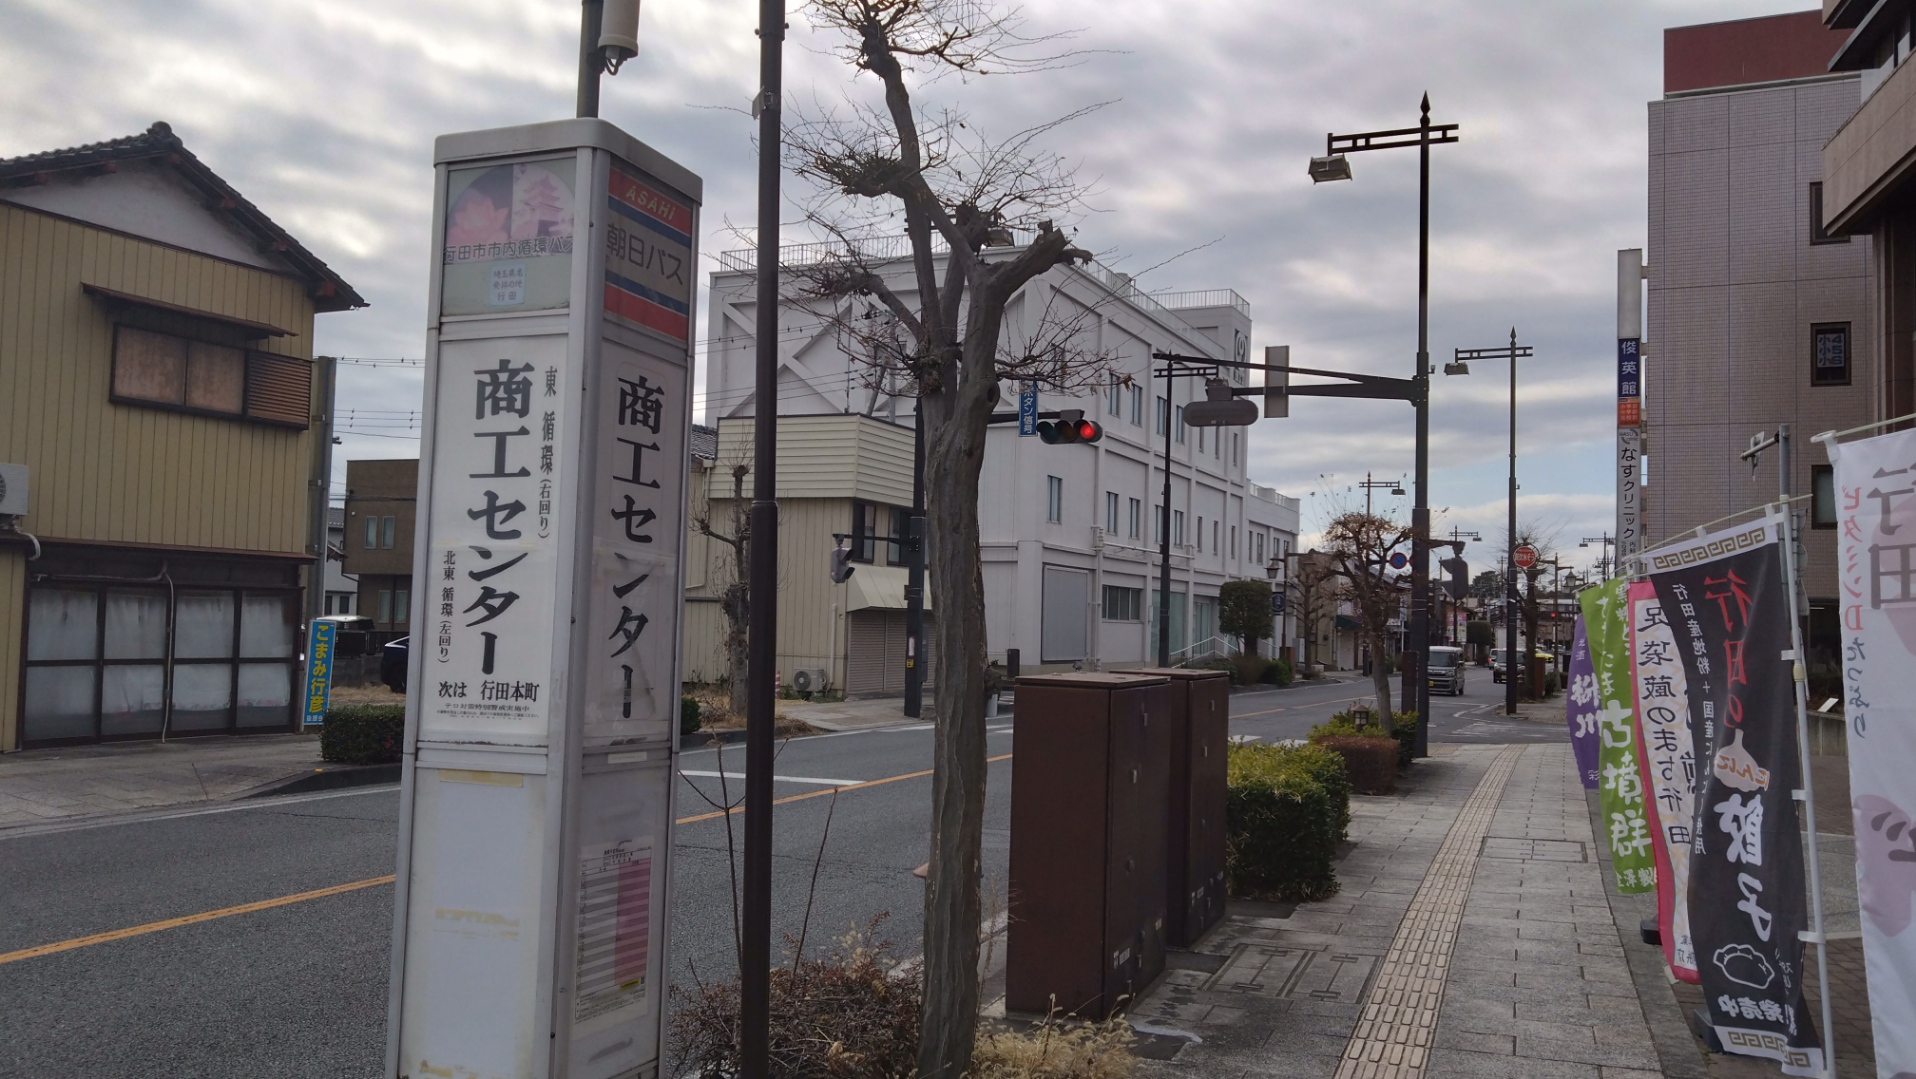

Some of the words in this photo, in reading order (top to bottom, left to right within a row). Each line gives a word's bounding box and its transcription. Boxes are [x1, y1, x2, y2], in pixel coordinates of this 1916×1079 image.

[606, 222, 683, 286] 朝日バス
[1621, 341, 1637, 395] 俊英館
[462, 359, 535, 675] 商工センター
[1621, 447, 1637, 539] なすクリニック
[608, 375, 665, 719] 商工センター
[438, 680, 467, 698] 次は
[480, 680, 540, 703] 行田本町
